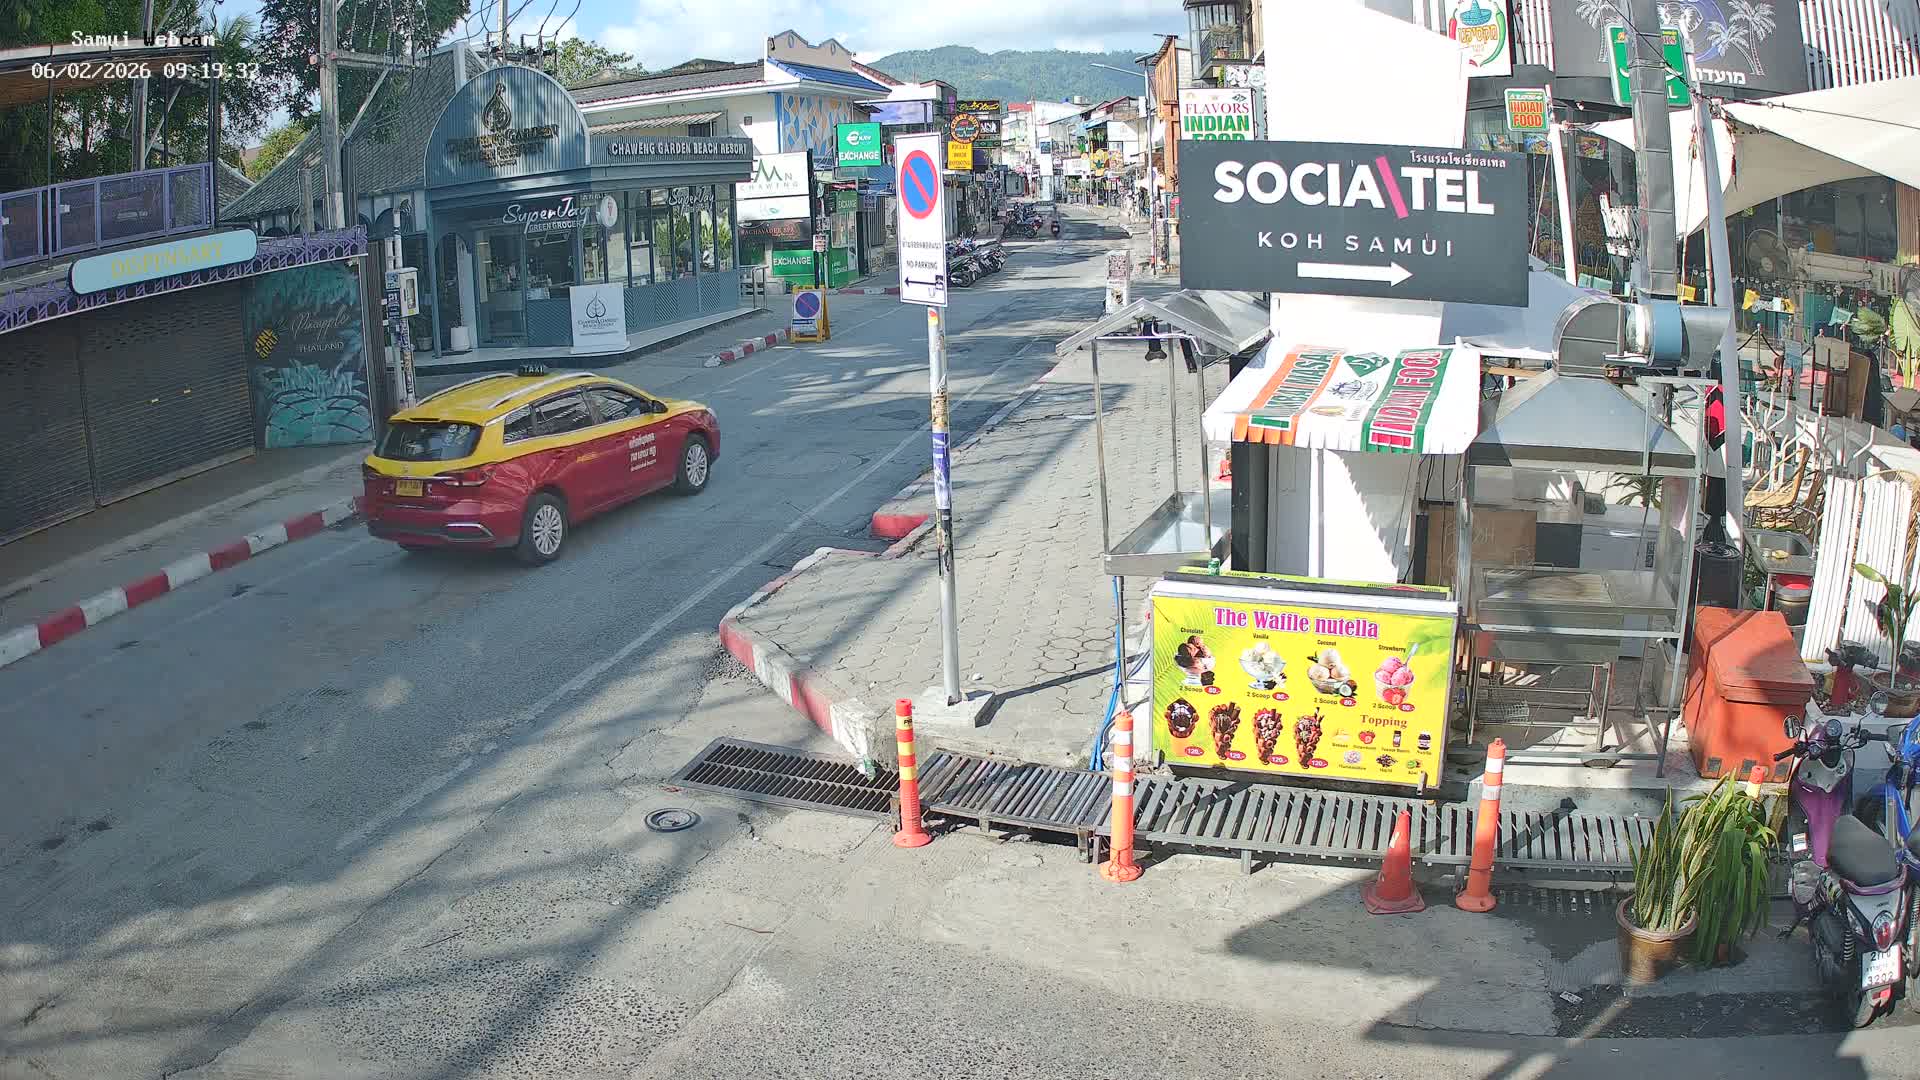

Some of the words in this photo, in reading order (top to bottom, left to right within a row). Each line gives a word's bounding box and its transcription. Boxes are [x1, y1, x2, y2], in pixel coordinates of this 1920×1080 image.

[1185, 102, 1249, 114] FLAVORS
[1510, 102, 1542, 112] INDIAN
[1184, 115, 1249, 131] INDIAN
[1513, 115, 1542, 126] FOOD
[611, 142, 655, 155] CHAWENG
[658, 142, 691, 154] GARDEN
[693, 142, 718, 154] BEACH
[839, 151, 879, 160] EXCHANGE
[1258, 231, 1324, 249] KOH
[1345, 235, 1452, 257] SAMUI
[773, 256, 811, 265] EXCHANGE
[915, 261, 938, 270] PARKING
[299, 341, 345, 353] THAILAND
[1214, 607, 1247, 627] The
[1253, 610, 1310, 633] Waffle
[1314, 615, 1379, 639] nutella
[1360, 714, 1408, 729] Topping
